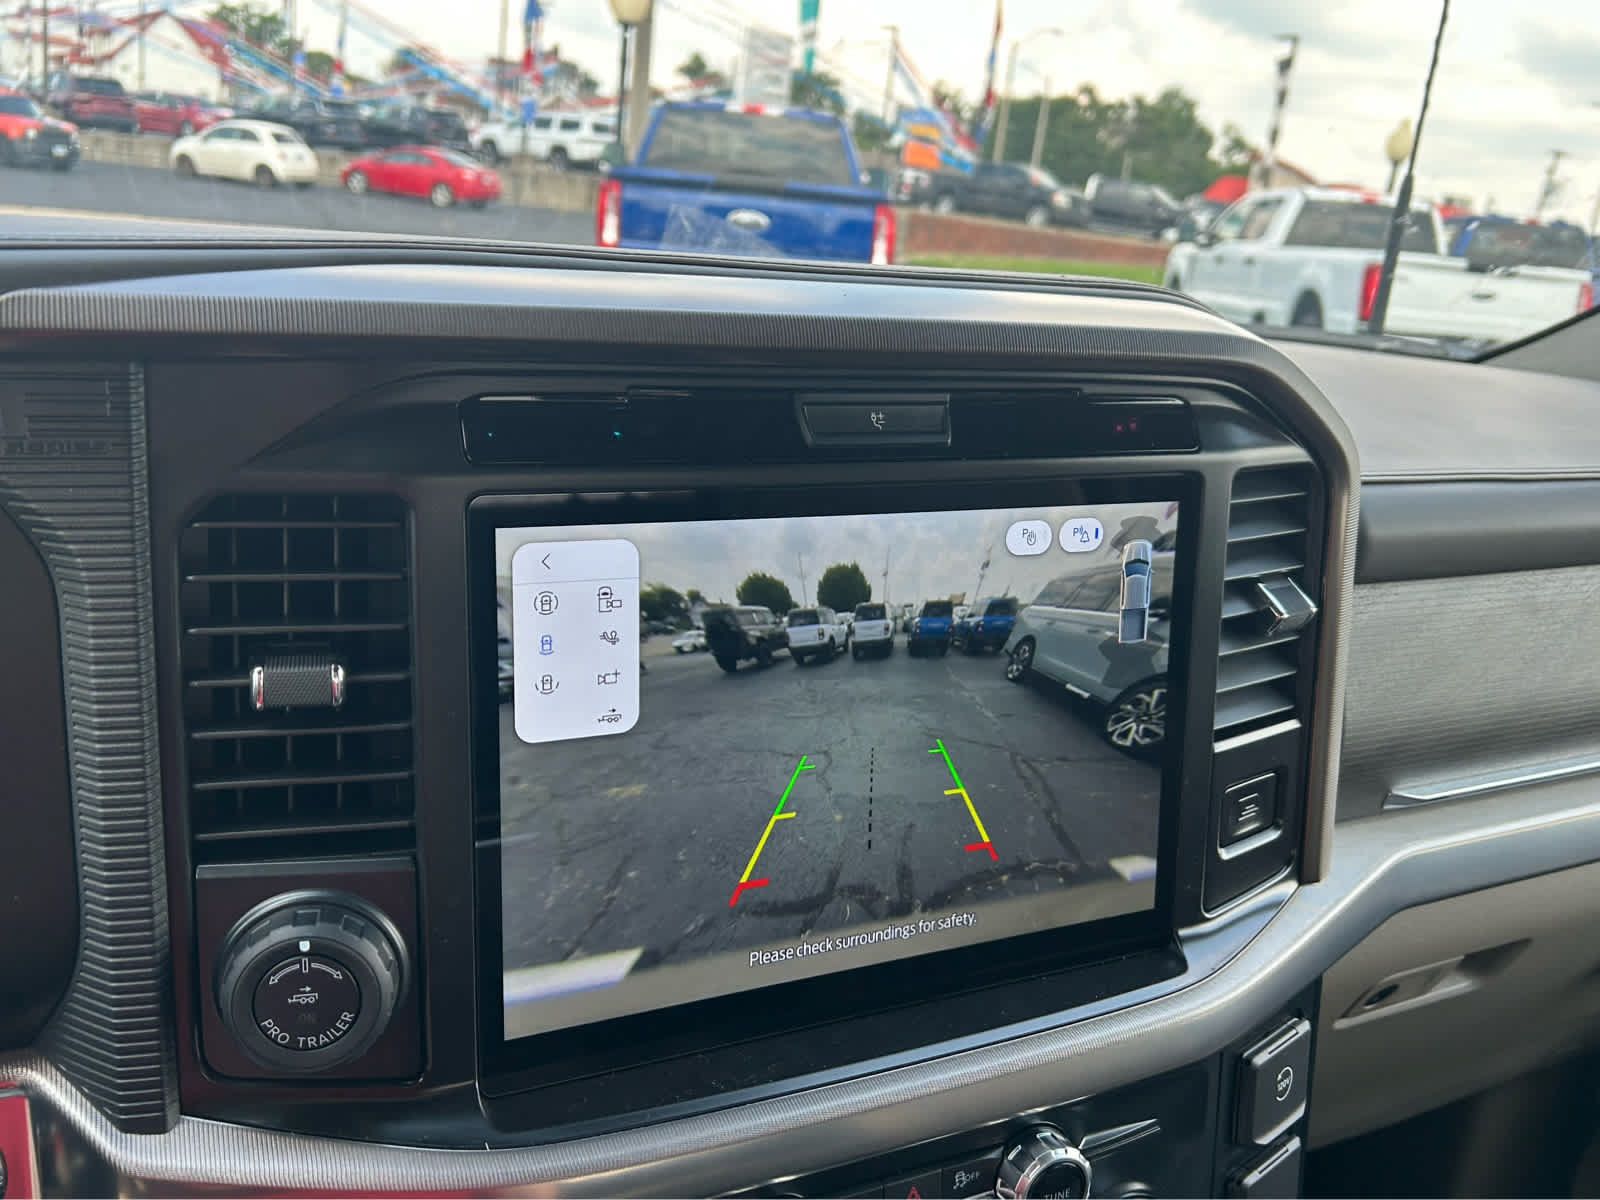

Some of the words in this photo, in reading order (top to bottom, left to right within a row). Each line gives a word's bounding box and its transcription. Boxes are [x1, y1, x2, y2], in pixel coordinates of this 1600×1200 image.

[749, 948, 794, 967] Please
[796, 937, 833, 957] check
[836, 923, 916, 950] surroundings
[919, 919, 937, 934] for
[938, 912, 977, 930] safety.
[260, 1018, 290, 1044] PRO
[297, 1011, 355, 1048] TRAILER
